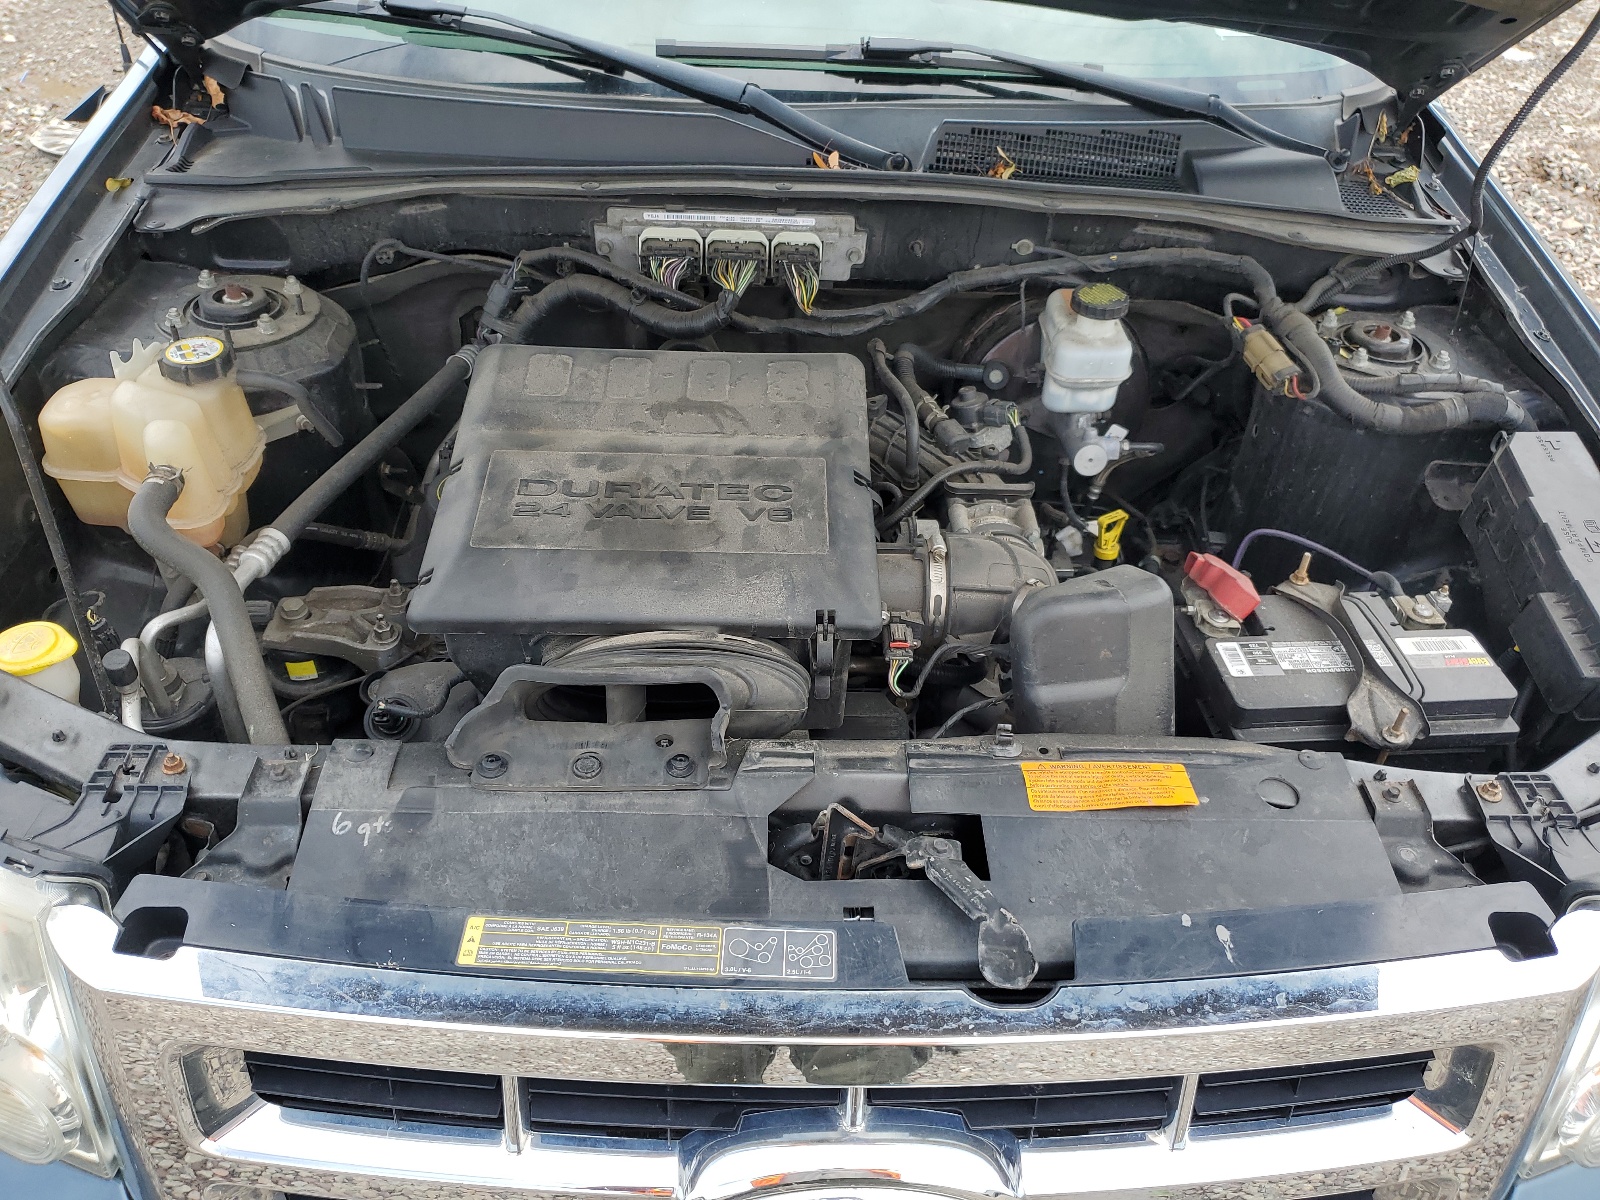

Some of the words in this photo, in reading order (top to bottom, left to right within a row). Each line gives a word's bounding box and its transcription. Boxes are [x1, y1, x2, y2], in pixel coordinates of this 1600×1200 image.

[516, 478, 794, 502] DURATEC
[511, 502, 571, 518] 24
[584, 503, 711, 521] VALVE
[737, 506, 794, 522] V6
[331, 811, 352, 836] 6
